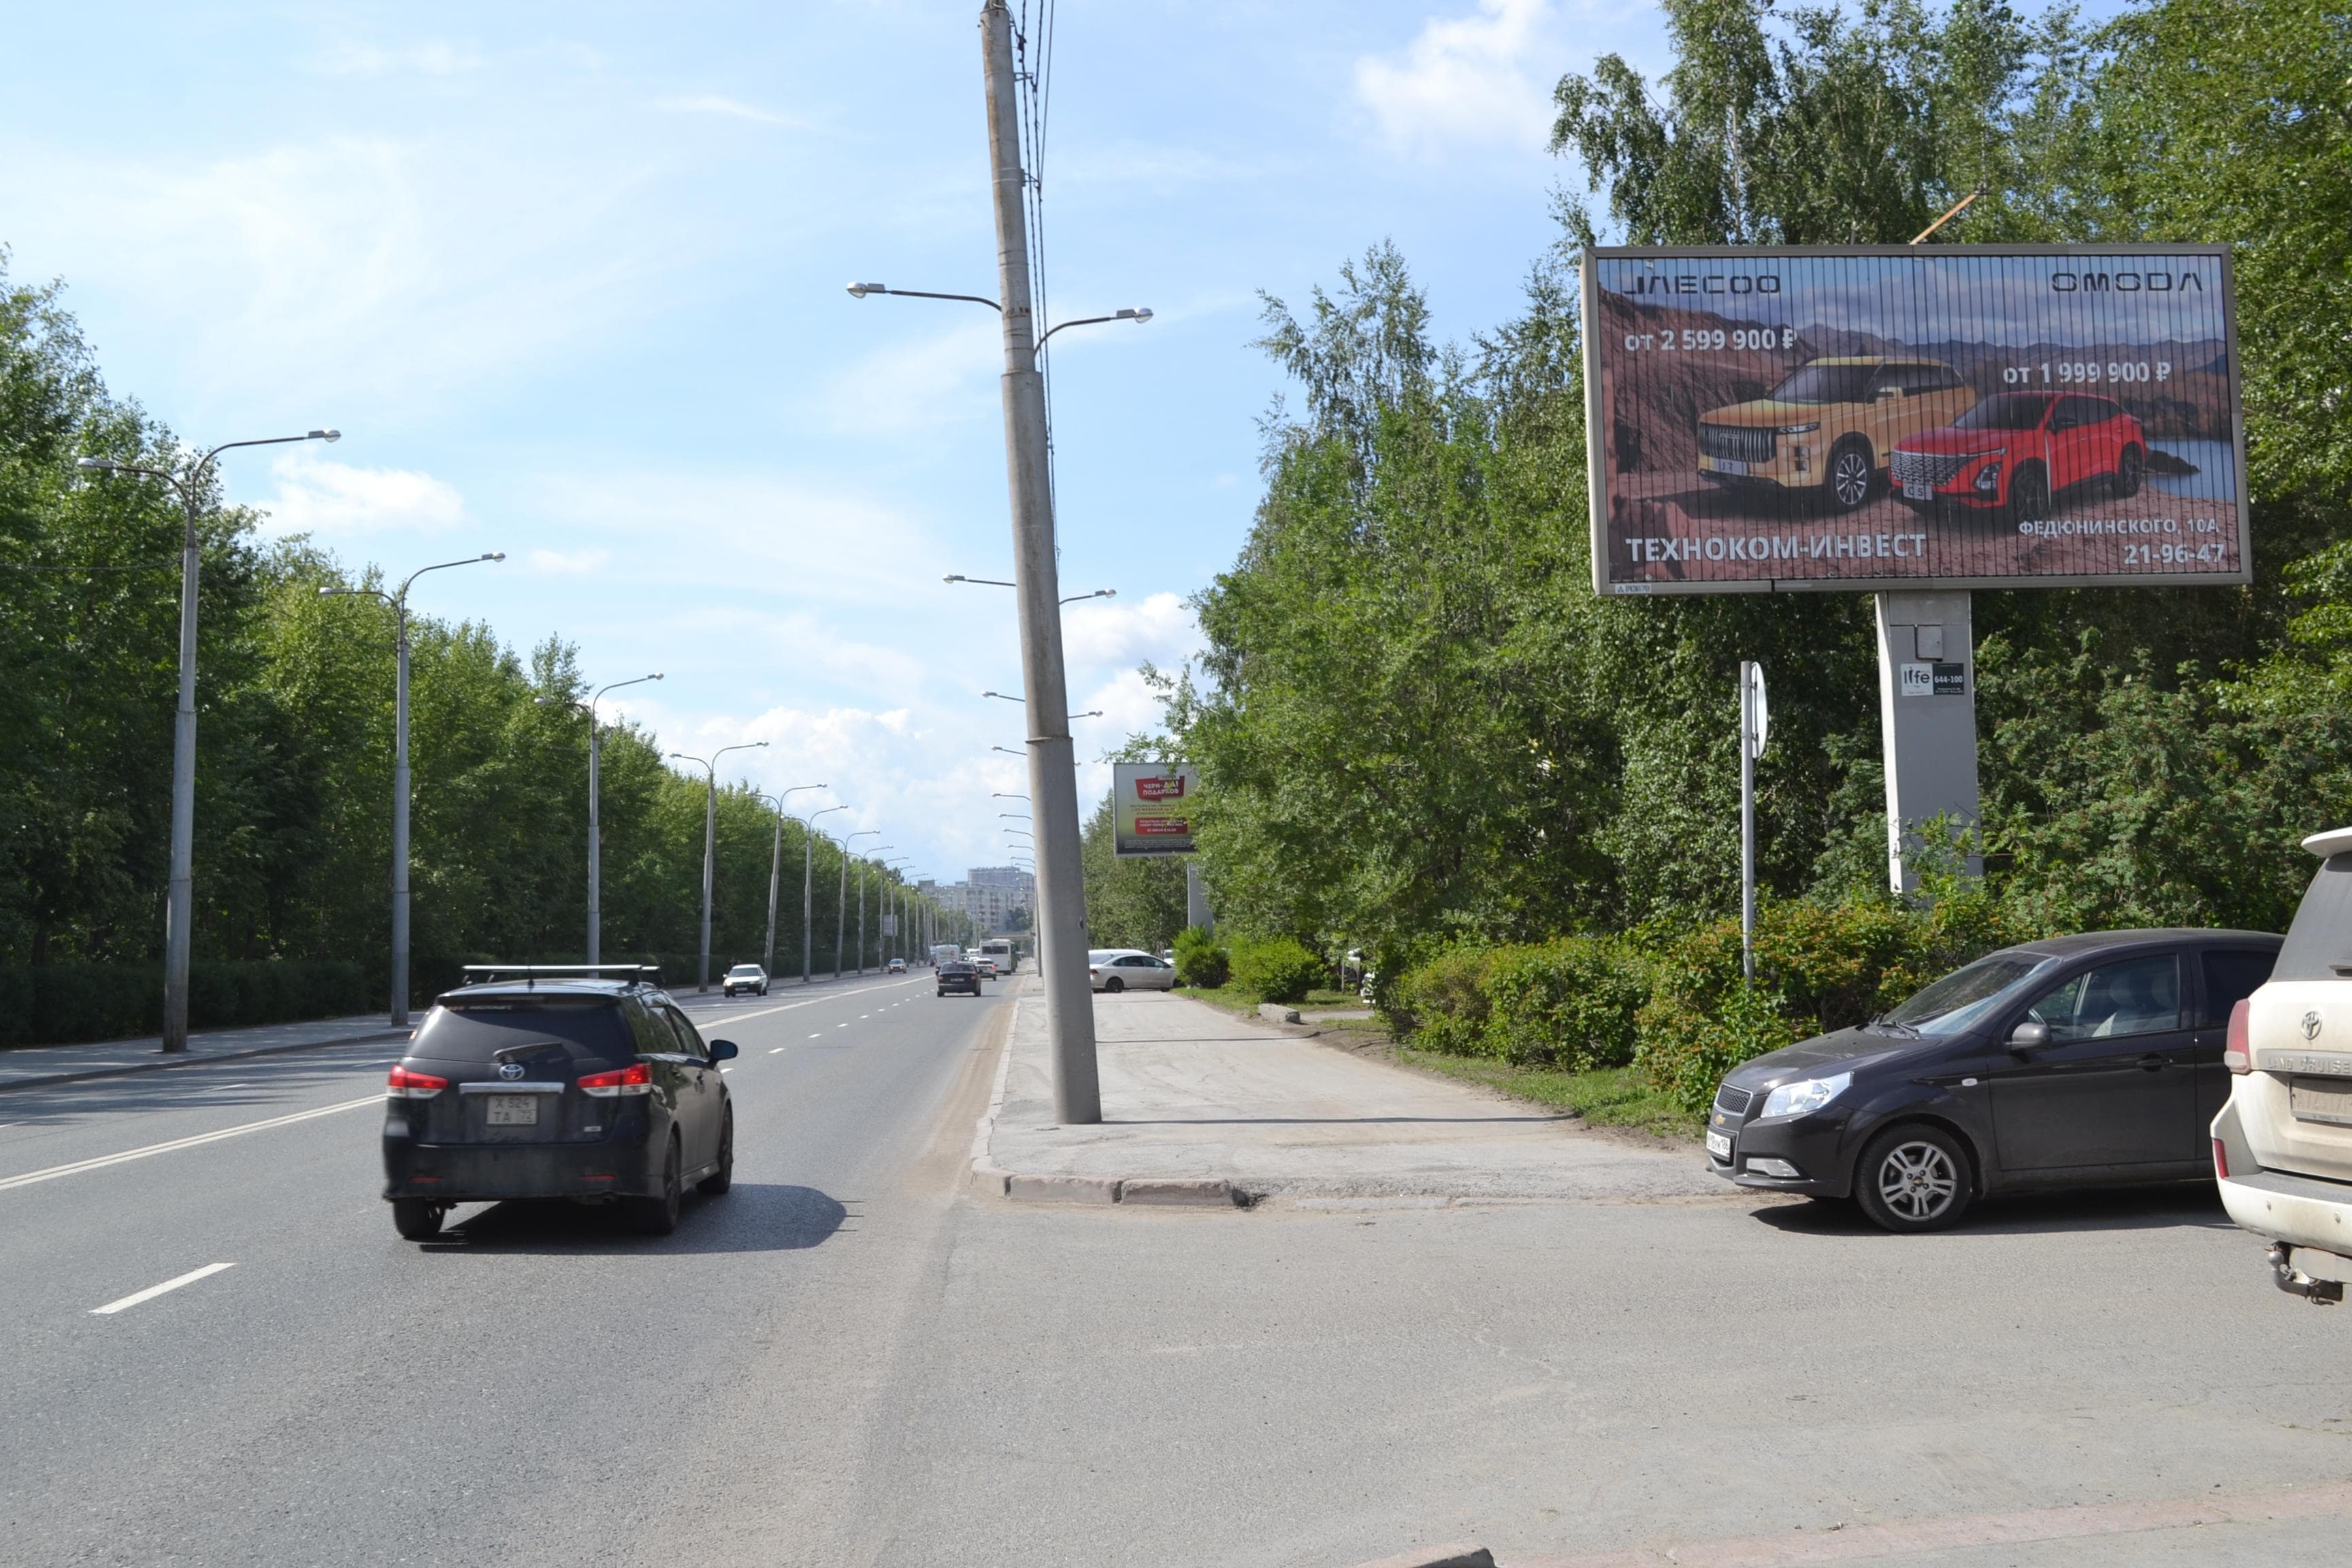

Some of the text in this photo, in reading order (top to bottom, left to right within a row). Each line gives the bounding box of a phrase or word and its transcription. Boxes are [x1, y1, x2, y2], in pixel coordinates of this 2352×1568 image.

[1623, 275, 1780, 294] JAECOO
[2051, 272, 2202, 291] OMODA
[1624, 334, 1654, 350] от
[1661, 329, 1676, 350] 2
[1682, 329, 1725, 350] 599
[1733, 329, 1776, 350] 900
[2003, 367, 2031, 383] от
[2039, 363, 2050, 382] 1
[2058, 362, 2101, 382] 999
[2108, 362, 2149, 382] 900
[2019, 517, 2220, 538] ФЕДЮНИНСКОГО, 10А
[1625, 534, 1926, 562] ТЕХНОКОМ-ИНВЕСТ
[2123, 544, 2225, 564] 21-96-47
[1934, 675, 1963, 684] 644-100
